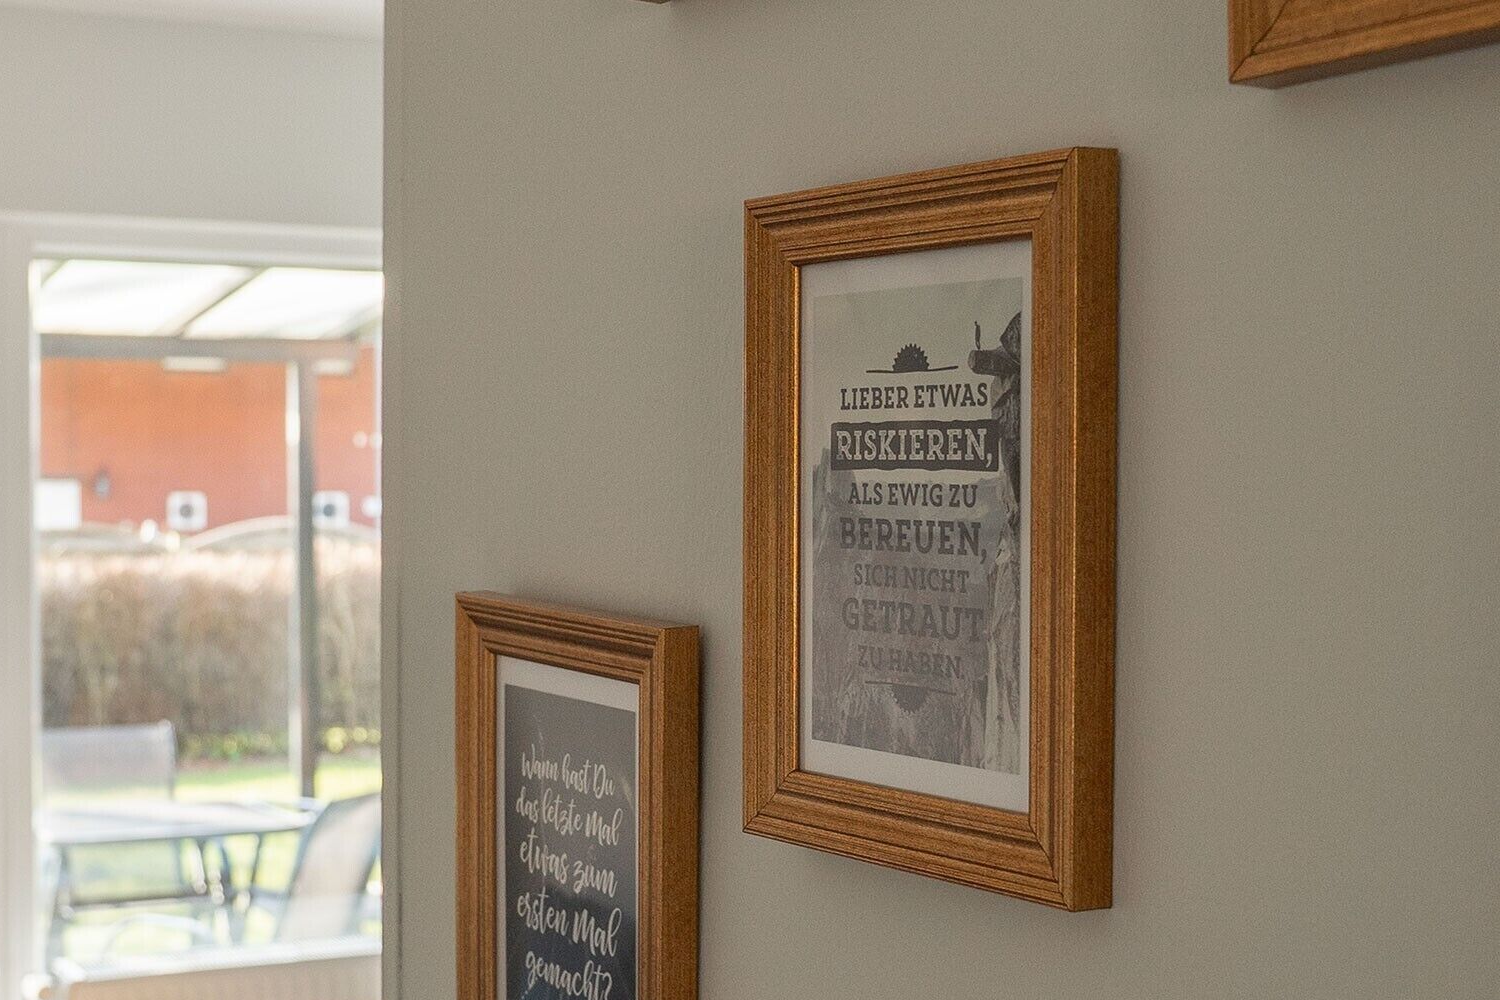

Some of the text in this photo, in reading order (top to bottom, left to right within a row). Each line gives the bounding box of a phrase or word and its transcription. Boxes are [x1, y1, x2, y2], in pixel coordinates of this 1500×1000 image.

[840, 382, 989, 411] LIEBER ETWAS
[835, 427, 993, 468] RISKIEREN,
[848, 482, 978, 509] ALS EWIG ZU
[839, 517, 988, 564] BEREUEN,
[853, 563, 970, 594] SICH NICHT
[841, 597, 985, 642] GETRAUT
[857, 644, 966, 680] ZU HABEN.
[521, 744, 616, 800] Wann hast Du
[515, 786, 624, 847] das letzte Mal
[519, 827, 619, 898] etwas zum
[517, 886, 623, 958] ersten Mal
